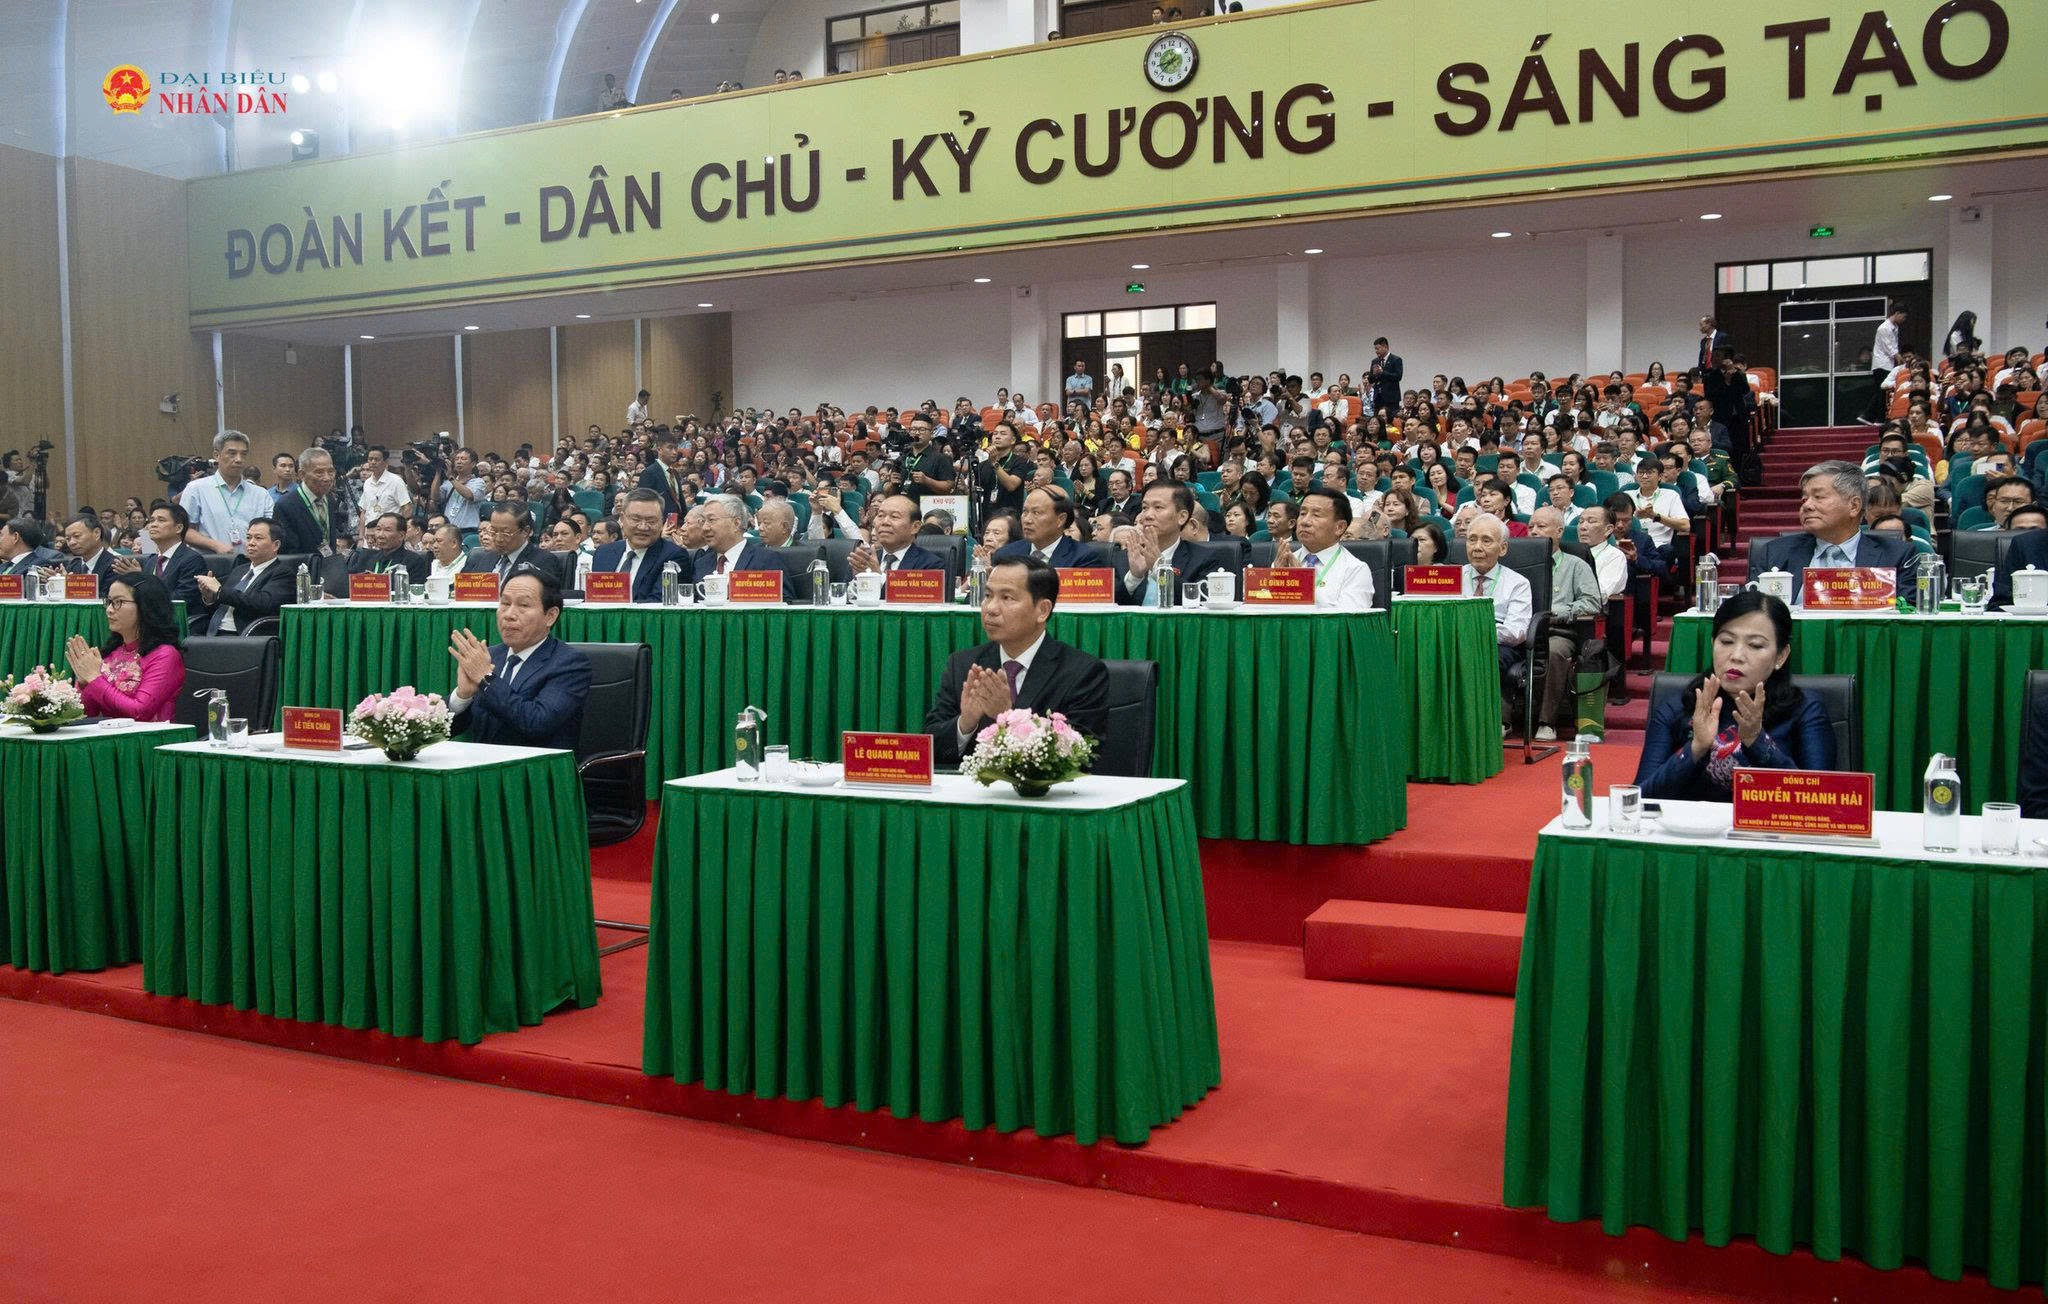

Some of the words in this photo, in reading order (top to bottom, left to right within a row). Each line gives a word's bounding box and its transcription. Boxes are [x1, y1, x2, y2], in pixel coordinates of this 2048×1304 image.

[225, 205, 364, 279] ĐOÀN
[383, 179, 486, 262] KẾT
[504, 212, 521, 226] -
[538, 164, 662, 243] DÂN
[690, 133, 821, 225] CHỦ
[845, 166, 866, 182] -
[892, 110, 990, 201] KỶ
[1014, 83, 1336, 185] CƯƠNG
[1367, 100, 1394, 119] -
[1433, 32, 1727, 138] SÁNG
[1764, 0, 2010, 112] TẠO
[854, 747, 865, 759] LÊ
[866, 749, 894, 760] QUANG
[895, 750, 921, 763] MẠNH
[1783, 775, 1804, 786] ĐỒNG
[1806, 777, 1820, 786] CHÍ
[1741, 787, 1791, 803] NGUYỄN
[1794, 792, 1837, 805] THANH
[1840, 791, 1863, 806] HẢI
